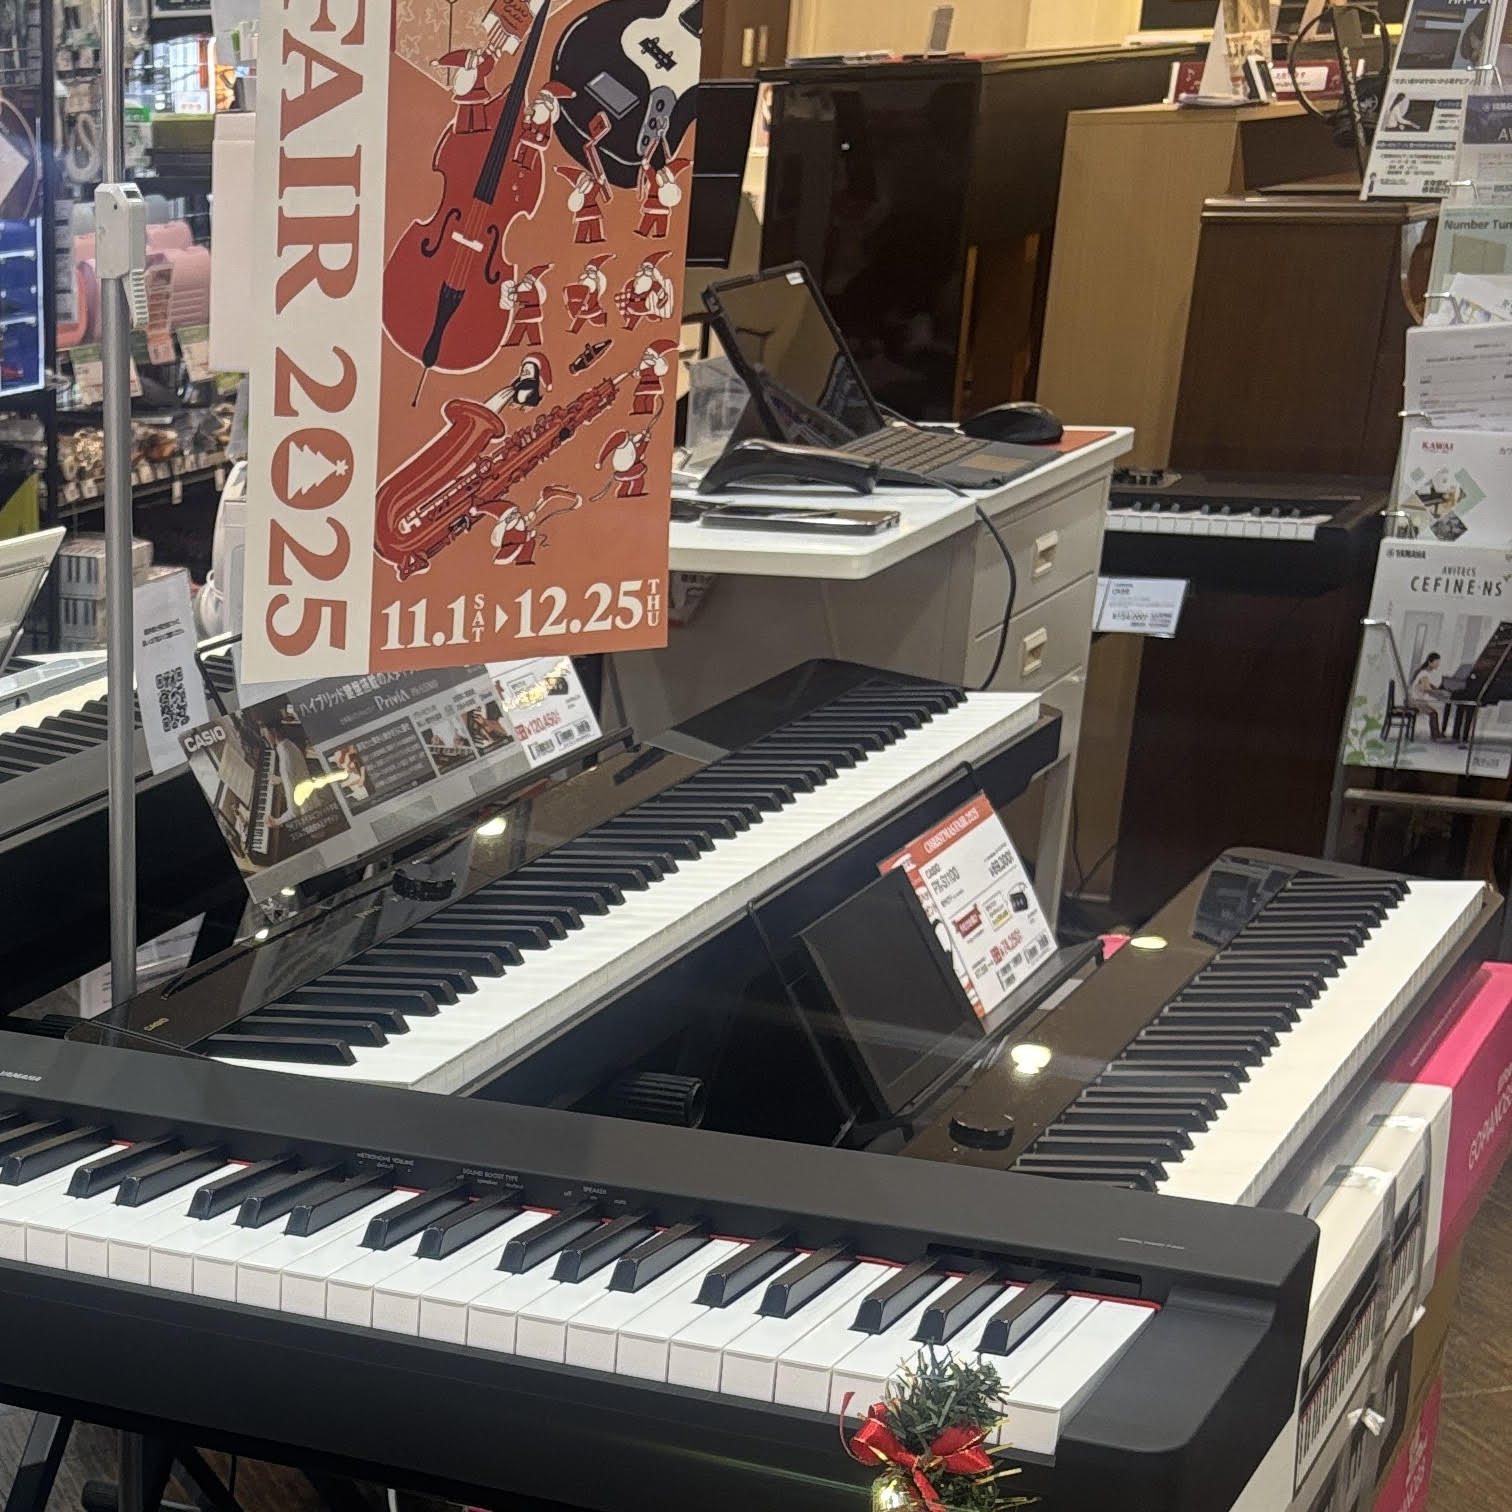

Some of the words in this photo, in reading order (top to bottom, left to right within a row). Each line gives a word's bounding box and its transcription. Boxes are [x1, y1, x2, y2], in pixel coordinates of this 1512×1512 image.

[276, 0, 363, 316] FAIR
[1444, 219, 1488, 231] Number
[1421, 441, 1454, 450] KAWAI
[265, 345, 358, 658] 2025
[380, 595, 469, 652] 11.1
[472, 593, 486, 644] SAT
[514, 580, 644, 641] 12.25
[647, 579, 661, 628] THU
[183, 725, 227, 753] CASIO
